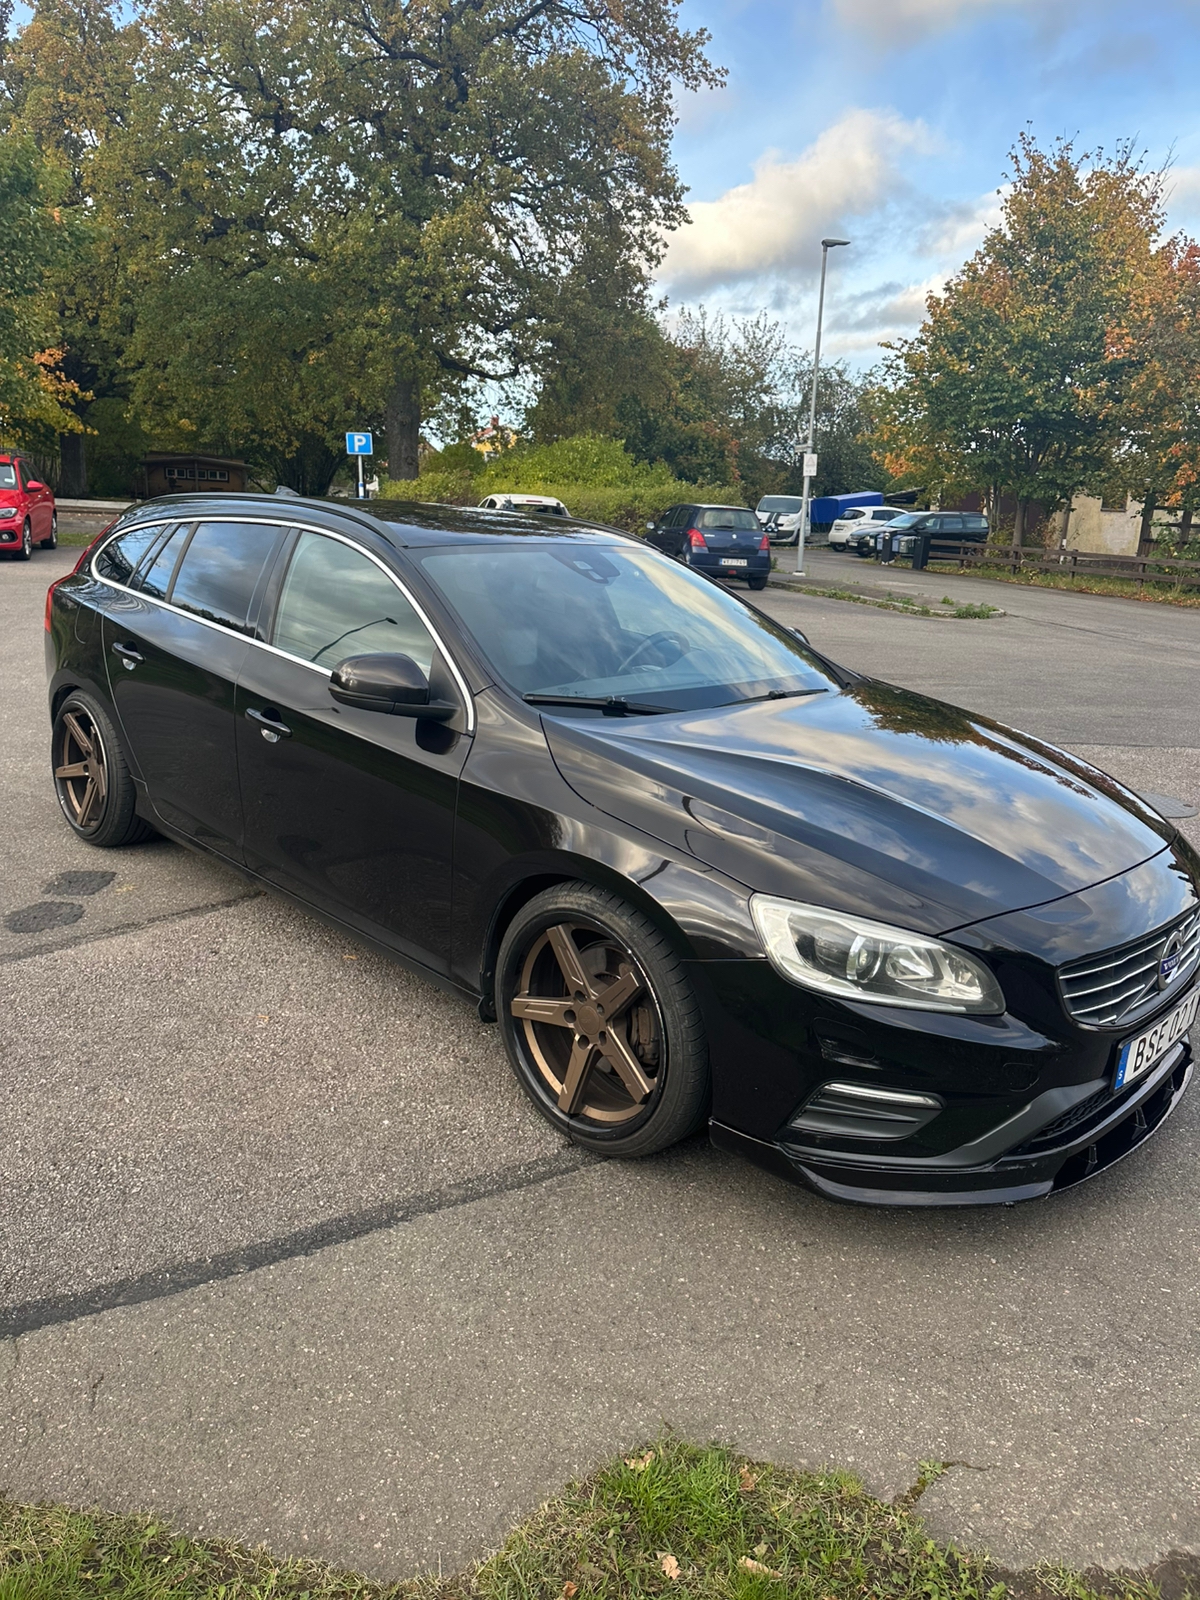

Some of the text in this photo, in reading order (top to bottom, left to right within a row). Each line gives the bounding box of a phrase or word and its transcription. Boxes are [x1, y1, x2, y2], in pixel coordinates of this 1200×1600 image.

[354, 435, 366, 452] P
[1133, 1019, 1168, 1073] BSE
[1118, 1069, 1124, 1080] S
